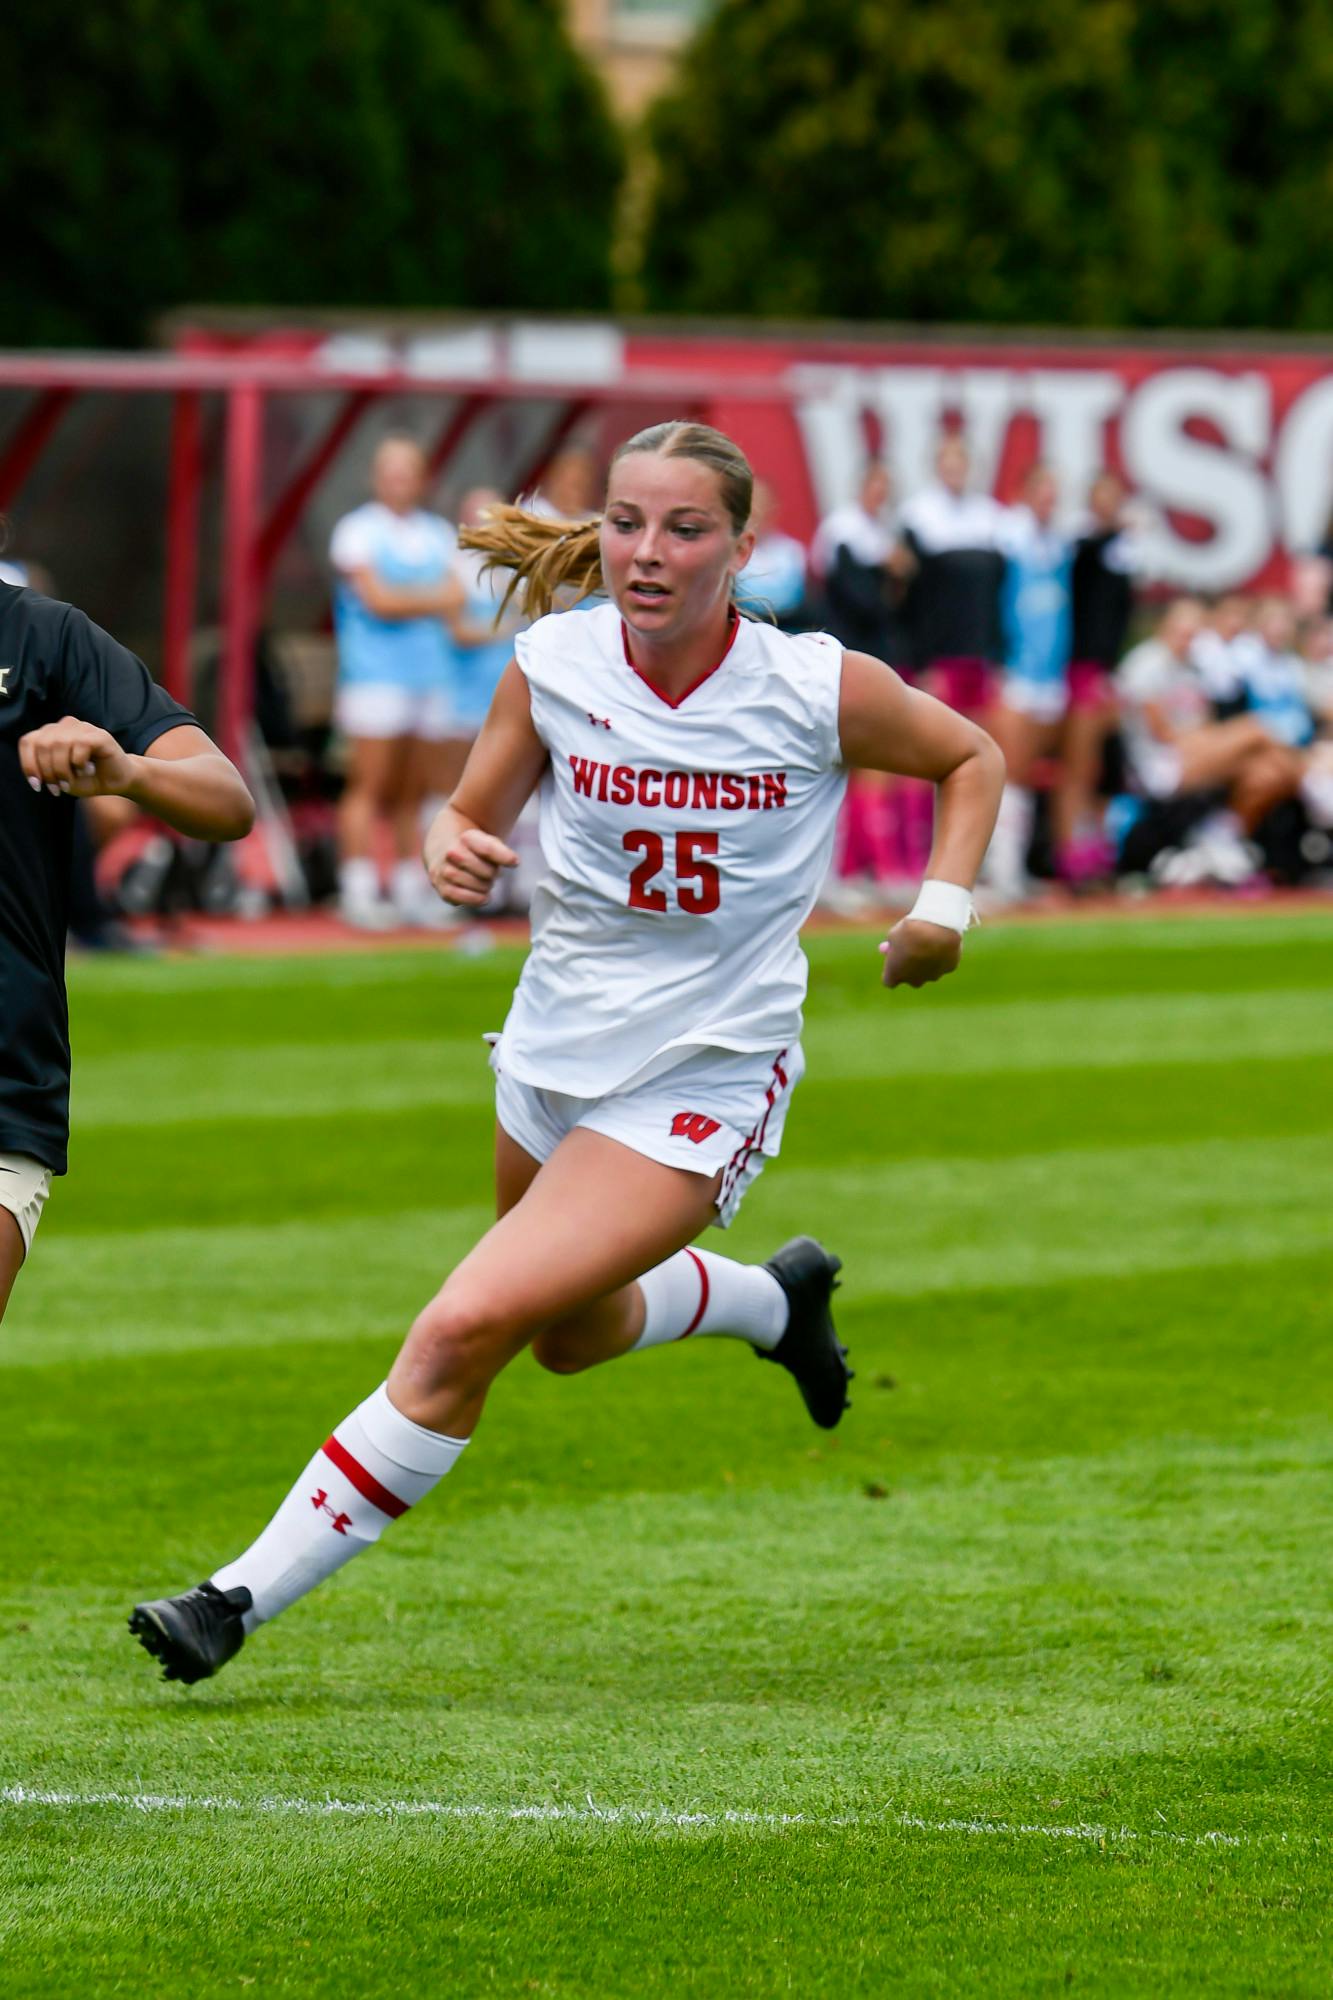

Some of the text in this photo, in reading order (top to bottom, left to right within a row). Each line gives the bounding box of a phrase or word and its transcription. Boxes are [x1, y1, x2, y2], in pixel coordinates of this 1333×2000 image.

[569, 755, 788, 811] WISCONSIN
[622, 828, 721, 916] 25
[669, 1112, 722, 1145] W
